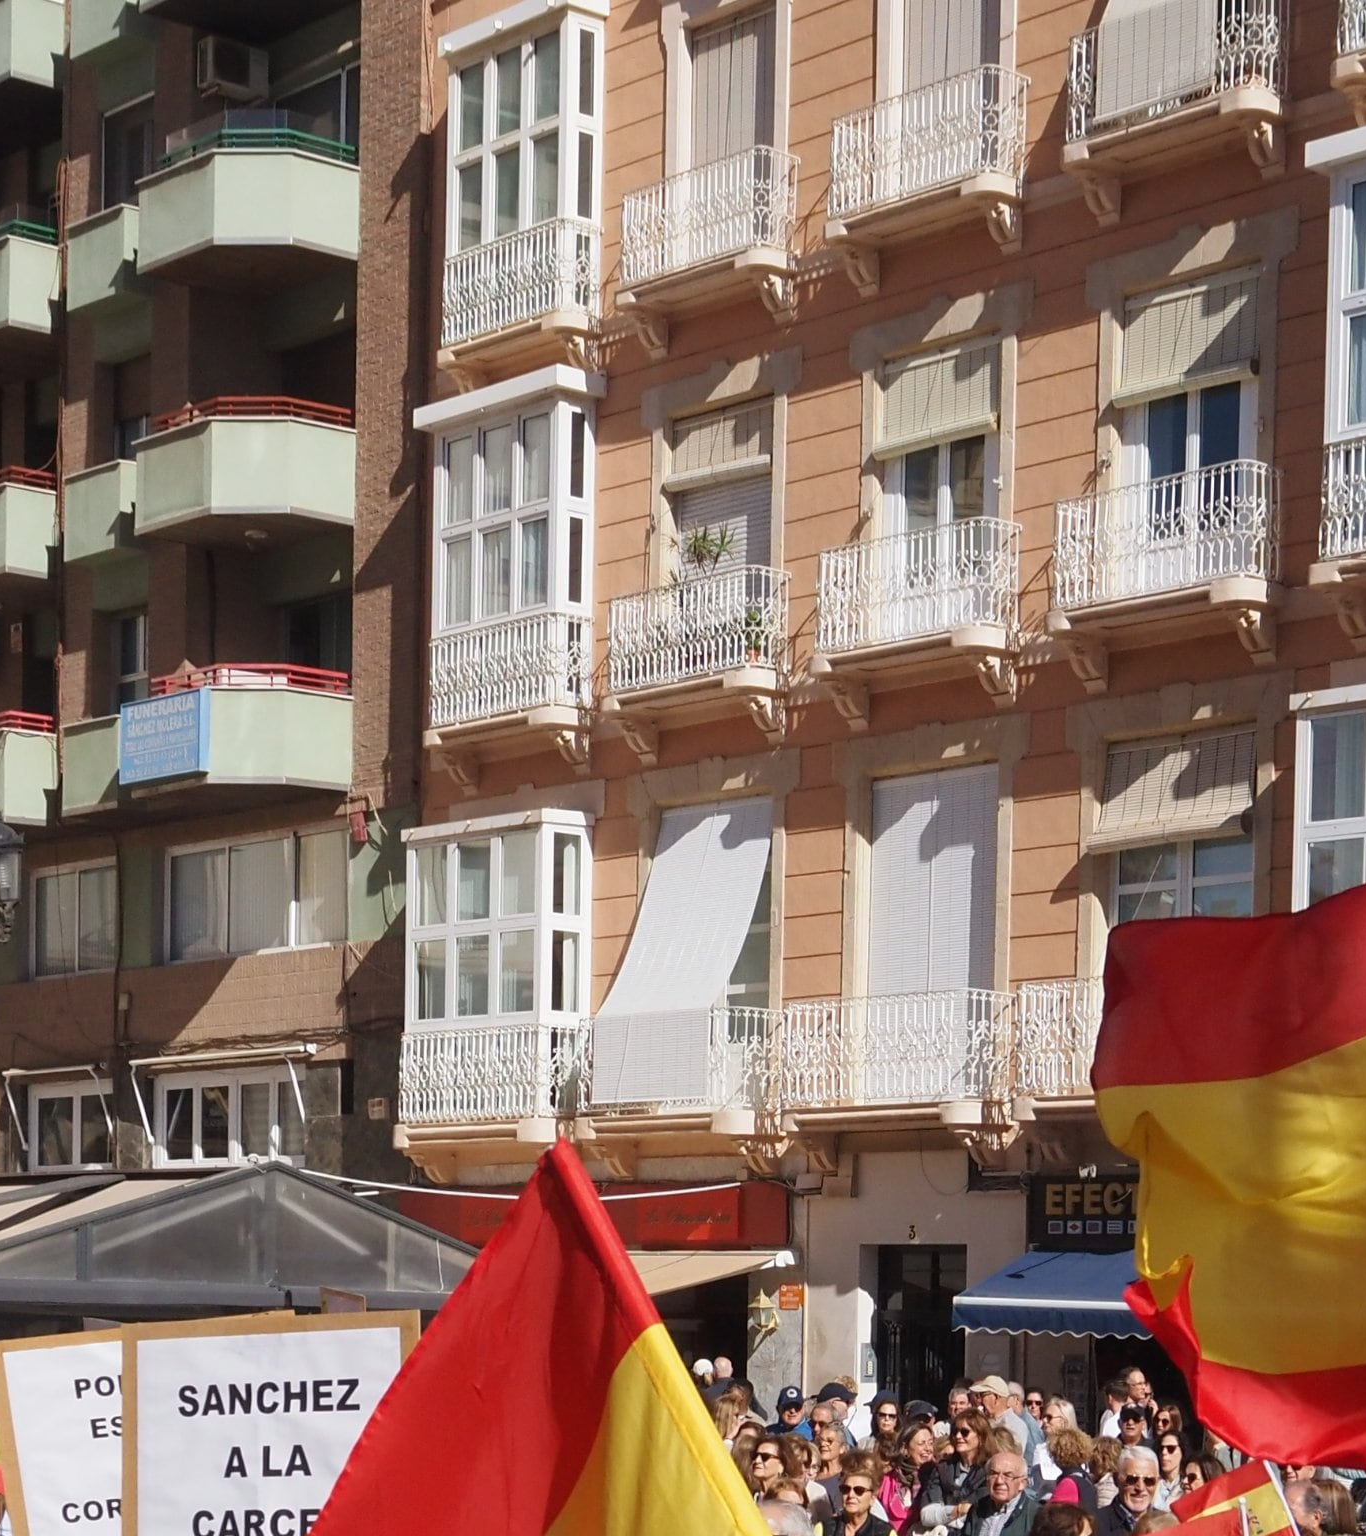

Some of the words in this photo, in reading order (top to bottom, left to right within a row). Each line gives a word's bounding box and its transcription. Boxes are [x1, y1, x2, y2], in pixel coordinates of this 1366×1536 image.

[127, 696, 194, 720] FUNERARIA
[908, 1224, 916, 1240] 3
[74, 1374, 122, 1399] PO
[177, 1378, 361, 1417] SANCHEZ
[224, 1446, 248, 1478] A
[261, 1444, 312, 1478] LA
